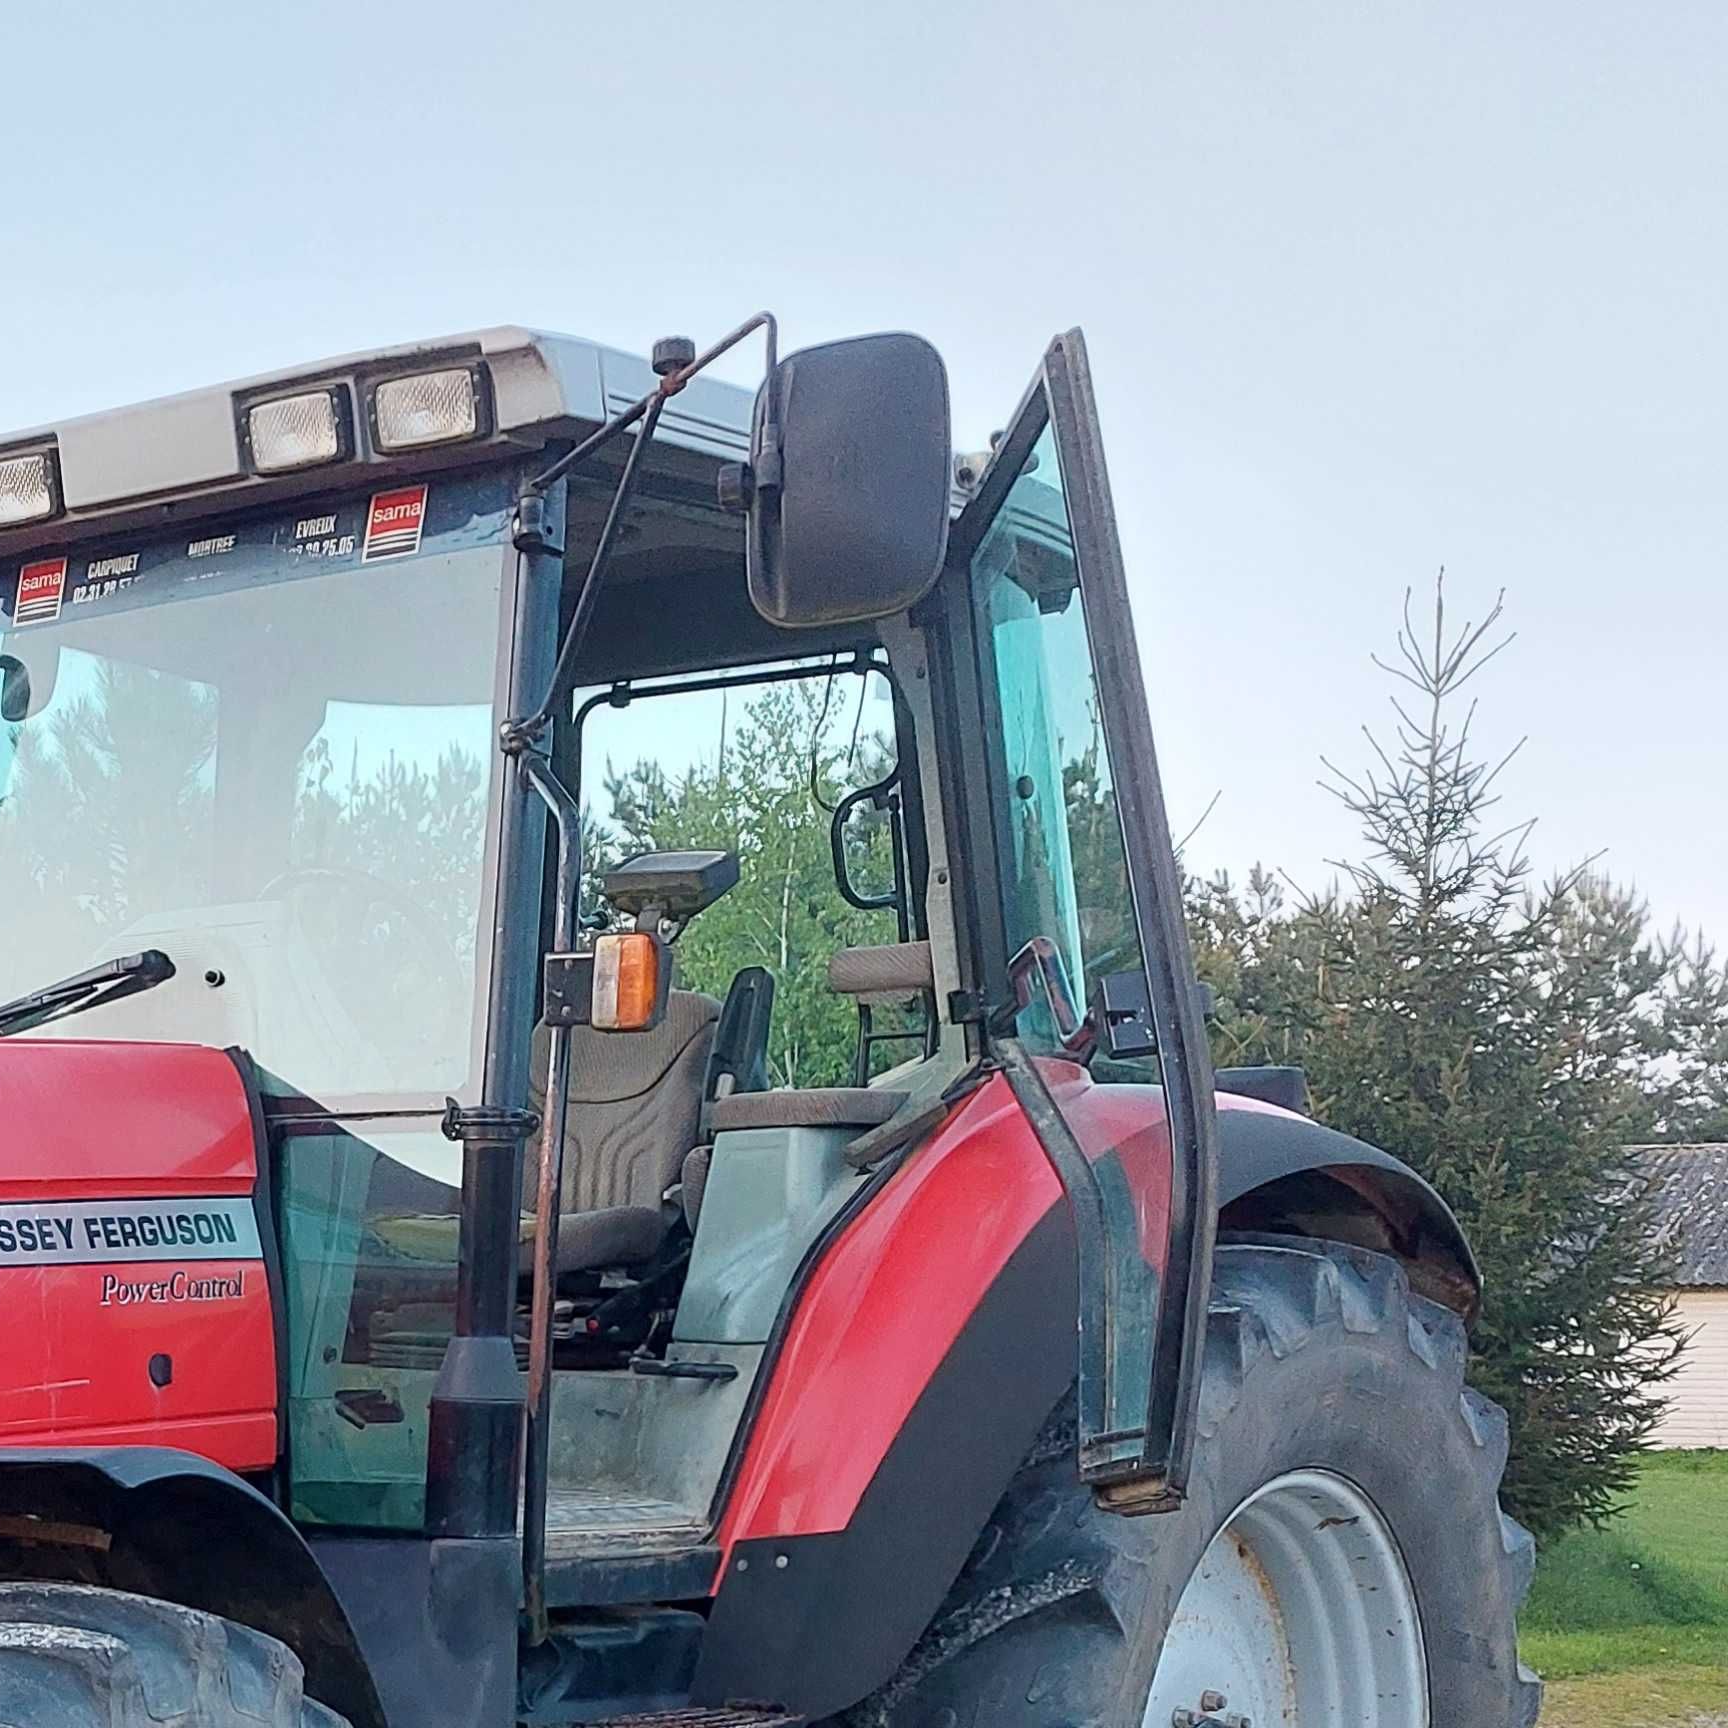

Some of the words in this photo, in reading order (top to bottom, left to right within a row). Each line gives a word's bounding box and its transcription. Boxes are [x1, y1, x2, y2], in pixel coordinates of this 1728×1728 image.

[373, 502, 421, 524] sama
[295, 514, 337, 539] EVREUX
[87, 553, 140, 580] CARPIQUET
[22, 572, 62, 592] sama
[84, 1212, 237, 1249] FERGUSON
